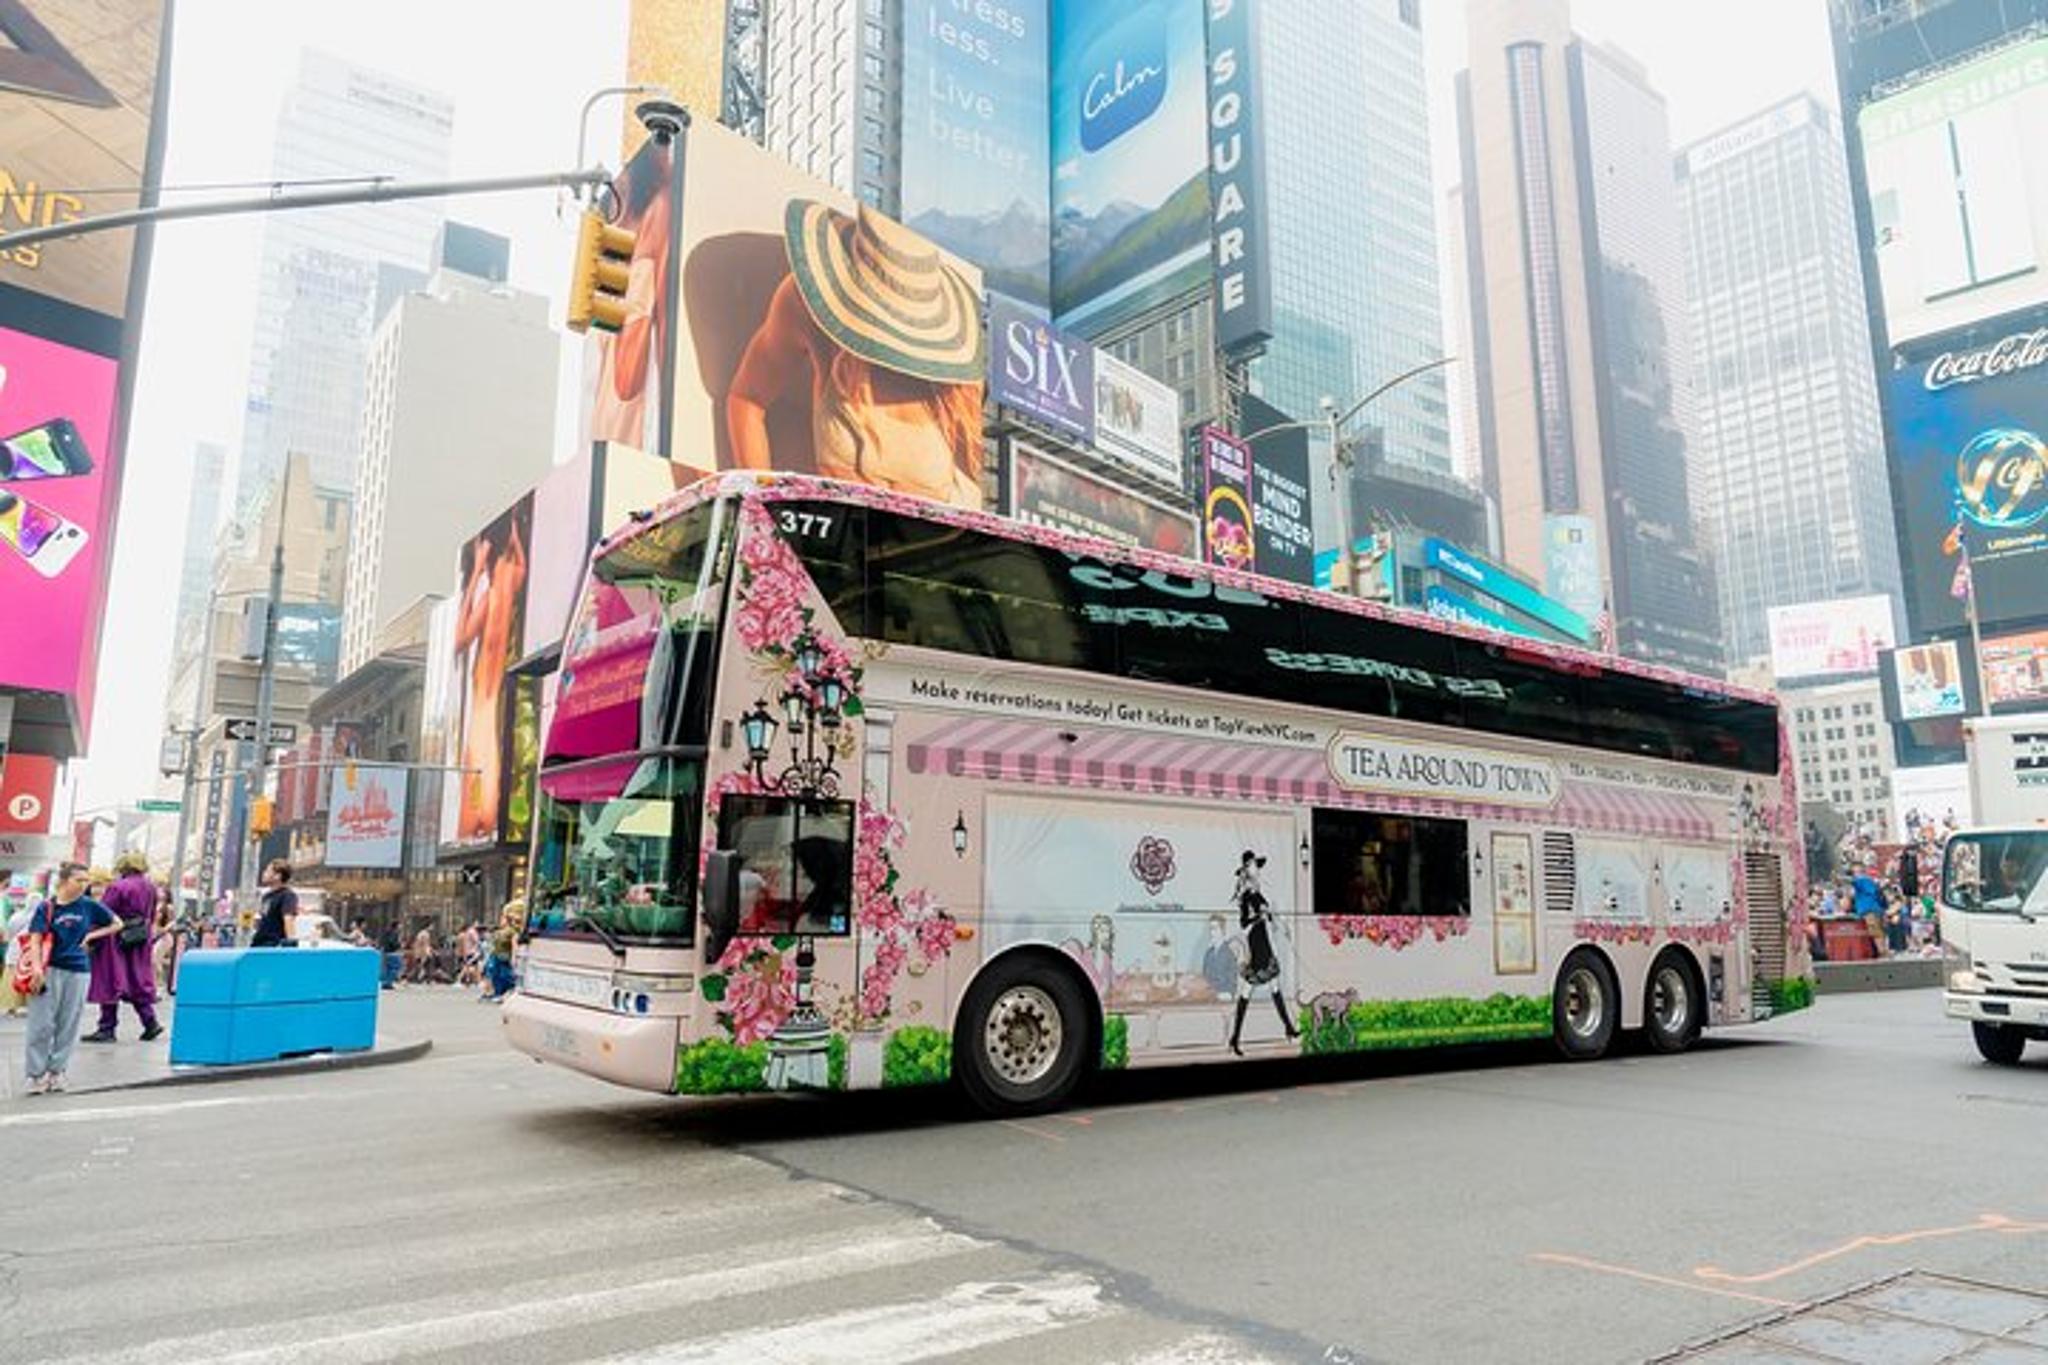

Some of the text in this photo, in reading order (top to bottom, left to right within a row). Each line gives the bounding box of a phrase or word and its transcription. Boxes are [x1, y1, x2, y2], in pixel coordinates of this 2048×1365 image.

[928, 5, 1000, 66] less.
[928, 67, 994, 119] Live
[1083, 59, 1163, 119] Calm
[1209, 47, 1245, 313] SQUARE
[781, 510, 832, 538] 377
[1253, 502, 1314, 549] BENDER
[1262, 482, 1301, 519] MIND
[911, 679, 960, 700] Make
[965, 689, 1062, 712] reservations
[1066, 701, 1113, 721] today!
[1117, 704, 1142, 721] Get
[1147, 709, 1190, 727] tickets
[1194, 716, 1210, 729] at
[1342, 745, 1551, 796] TEA AROUND TOWN
